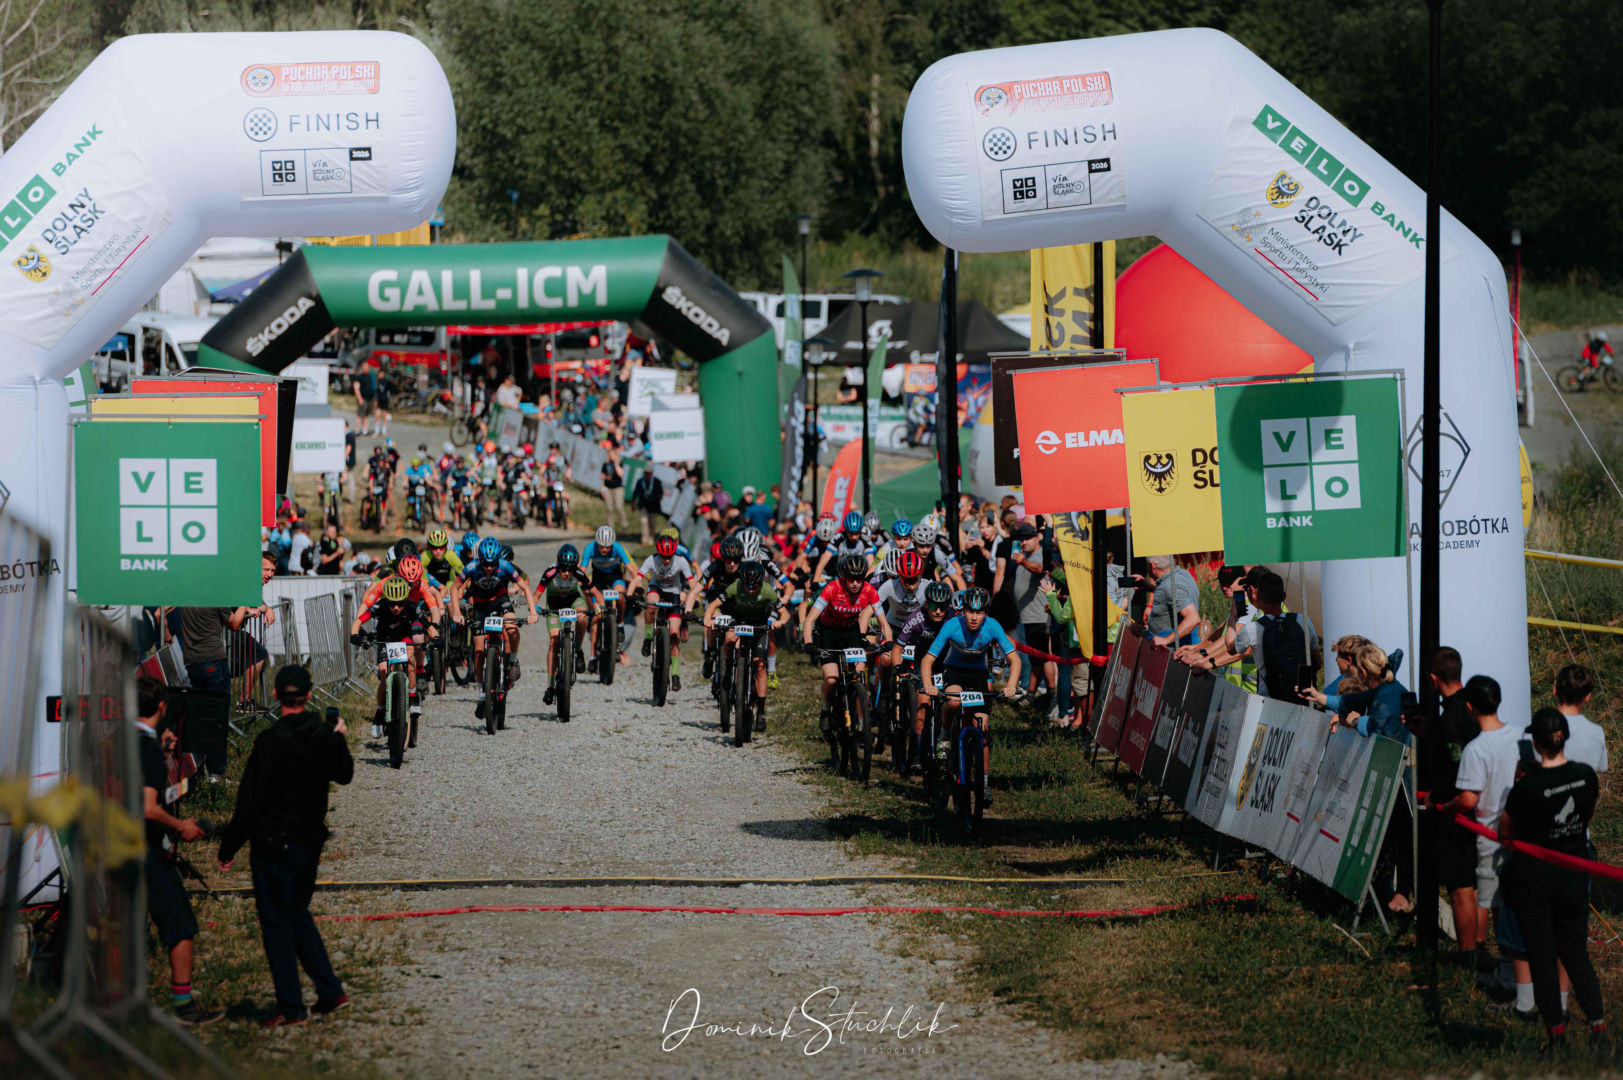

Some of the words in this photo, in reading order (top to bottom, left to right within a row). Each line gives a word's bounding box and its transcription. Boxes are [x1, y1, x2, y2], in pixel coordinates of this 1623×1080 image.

[281, 65, 329, 81] PUCHAR
[331, 64, 375, 80] POLSKI
[1013, 79, 1062, 99] PUCHAR
[1062, 75, 1107, 94] POLSKI
[289, 112, 380, 132] FINISH
[1027, 122, 1118, 150] FINISH
[52, 123, 104, 177] BANK
[351, 150, 370, 158] 2026
[1091, 162, 1108, 170] 2026
[1264, 111, 1362, 198] VELO
[1370, 200, 1427, 250] BANK
[41, 187, 93, 244] DOLNY
[1304, 196, 1365, 243] DOLNY
[53, 202, 106, 256] ŚLĄSK
[1294, 207, 1350, 257] ŚLĄSK
[1267, 226, 1320, 272] Ministerstwo
[1260, 236, 1288, 263] Sportu
[1292, 260, 1329, 294] Turystyki
[367, 264, 608, 312] GALL-ICM
[1064, 428, 1125, 448] ELMA
[1191, 446, 1219, 467] DO
[1193, 465, 1220, 490] ŚL
[1266, 515, 1313, 529] BANK
[1441, 514, 1510, 537] OBÓTKA
[1439, 539, 1481, 551] CADEMY
[0, 558, 61, 581] BÓTKA
[120, 558, 169, 571] BANK
[961, 692, 982, 702] 204
